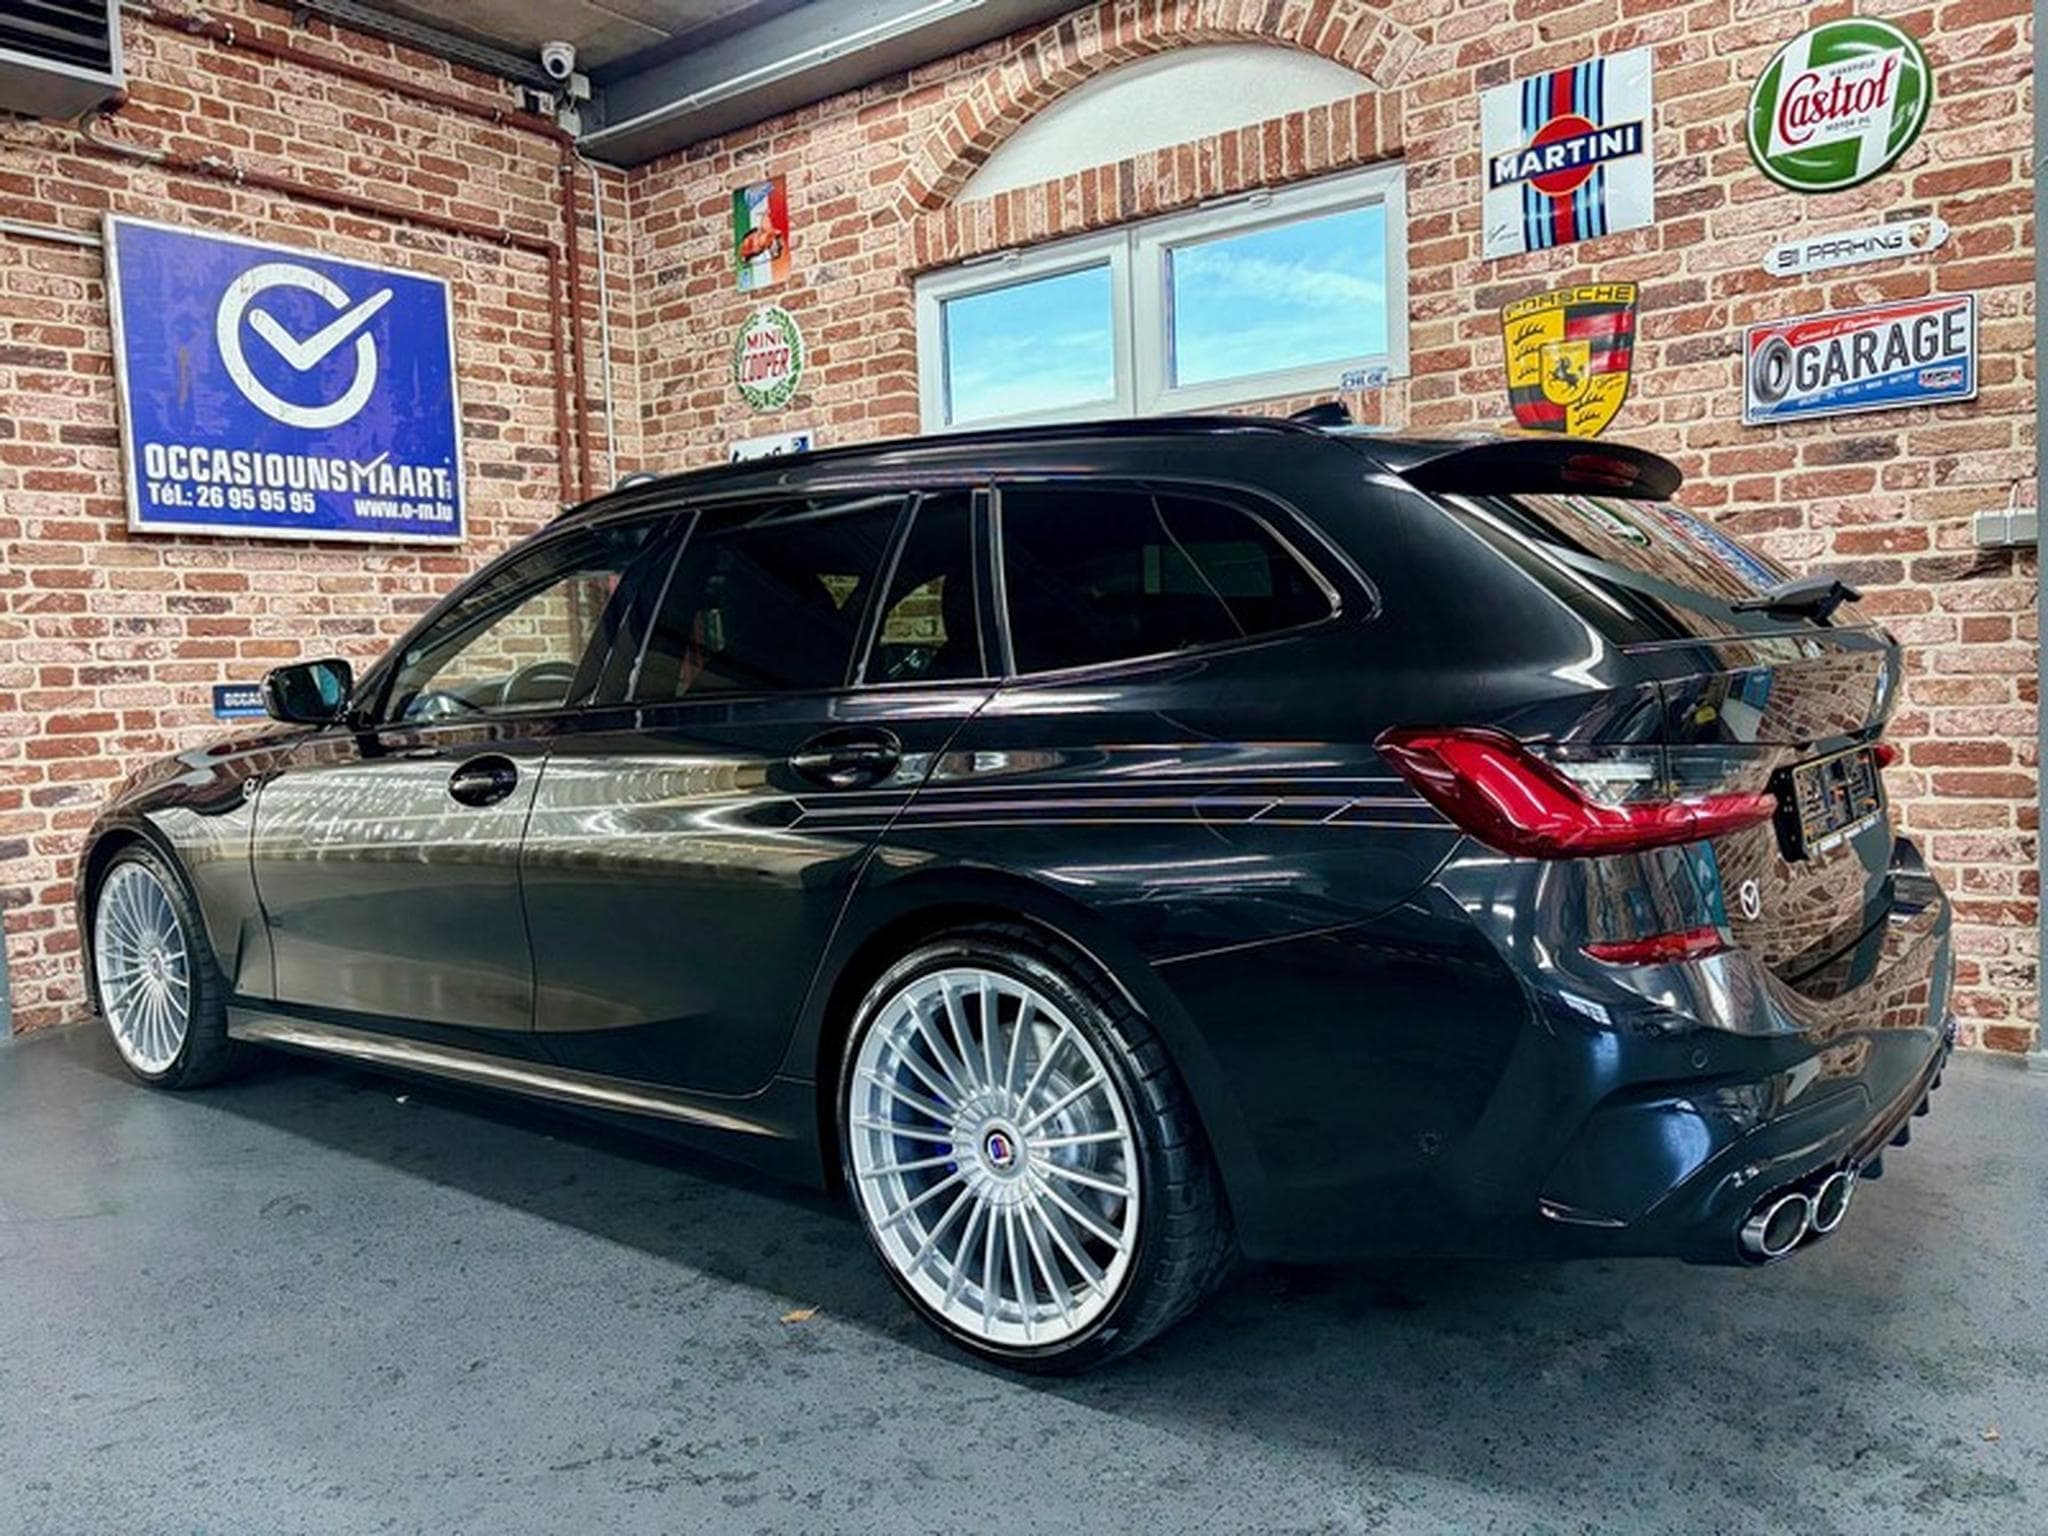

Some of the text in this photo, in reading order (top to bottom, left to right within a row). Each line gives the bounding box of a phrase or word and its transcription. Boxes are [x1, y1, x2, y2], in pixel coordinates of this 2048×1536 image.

[1779, 55, 1898, 145] Castrol
[1494, 127, 1636, 184] MARTINI
[1806, 231, 1903, 263] PARKING
[1508, 286, 1632, 318] PORSCHE
[746, 330, 782, 349] MINI
[1796, 306, 1967, 392] GARAGE
[742, 348, 789, 382] COOPER
[196, 485, 224, 509] 26
[228, 486, 256, 511] 95
[259, 488, 287, 513] 95
[289, 491, 316, 514] 95
